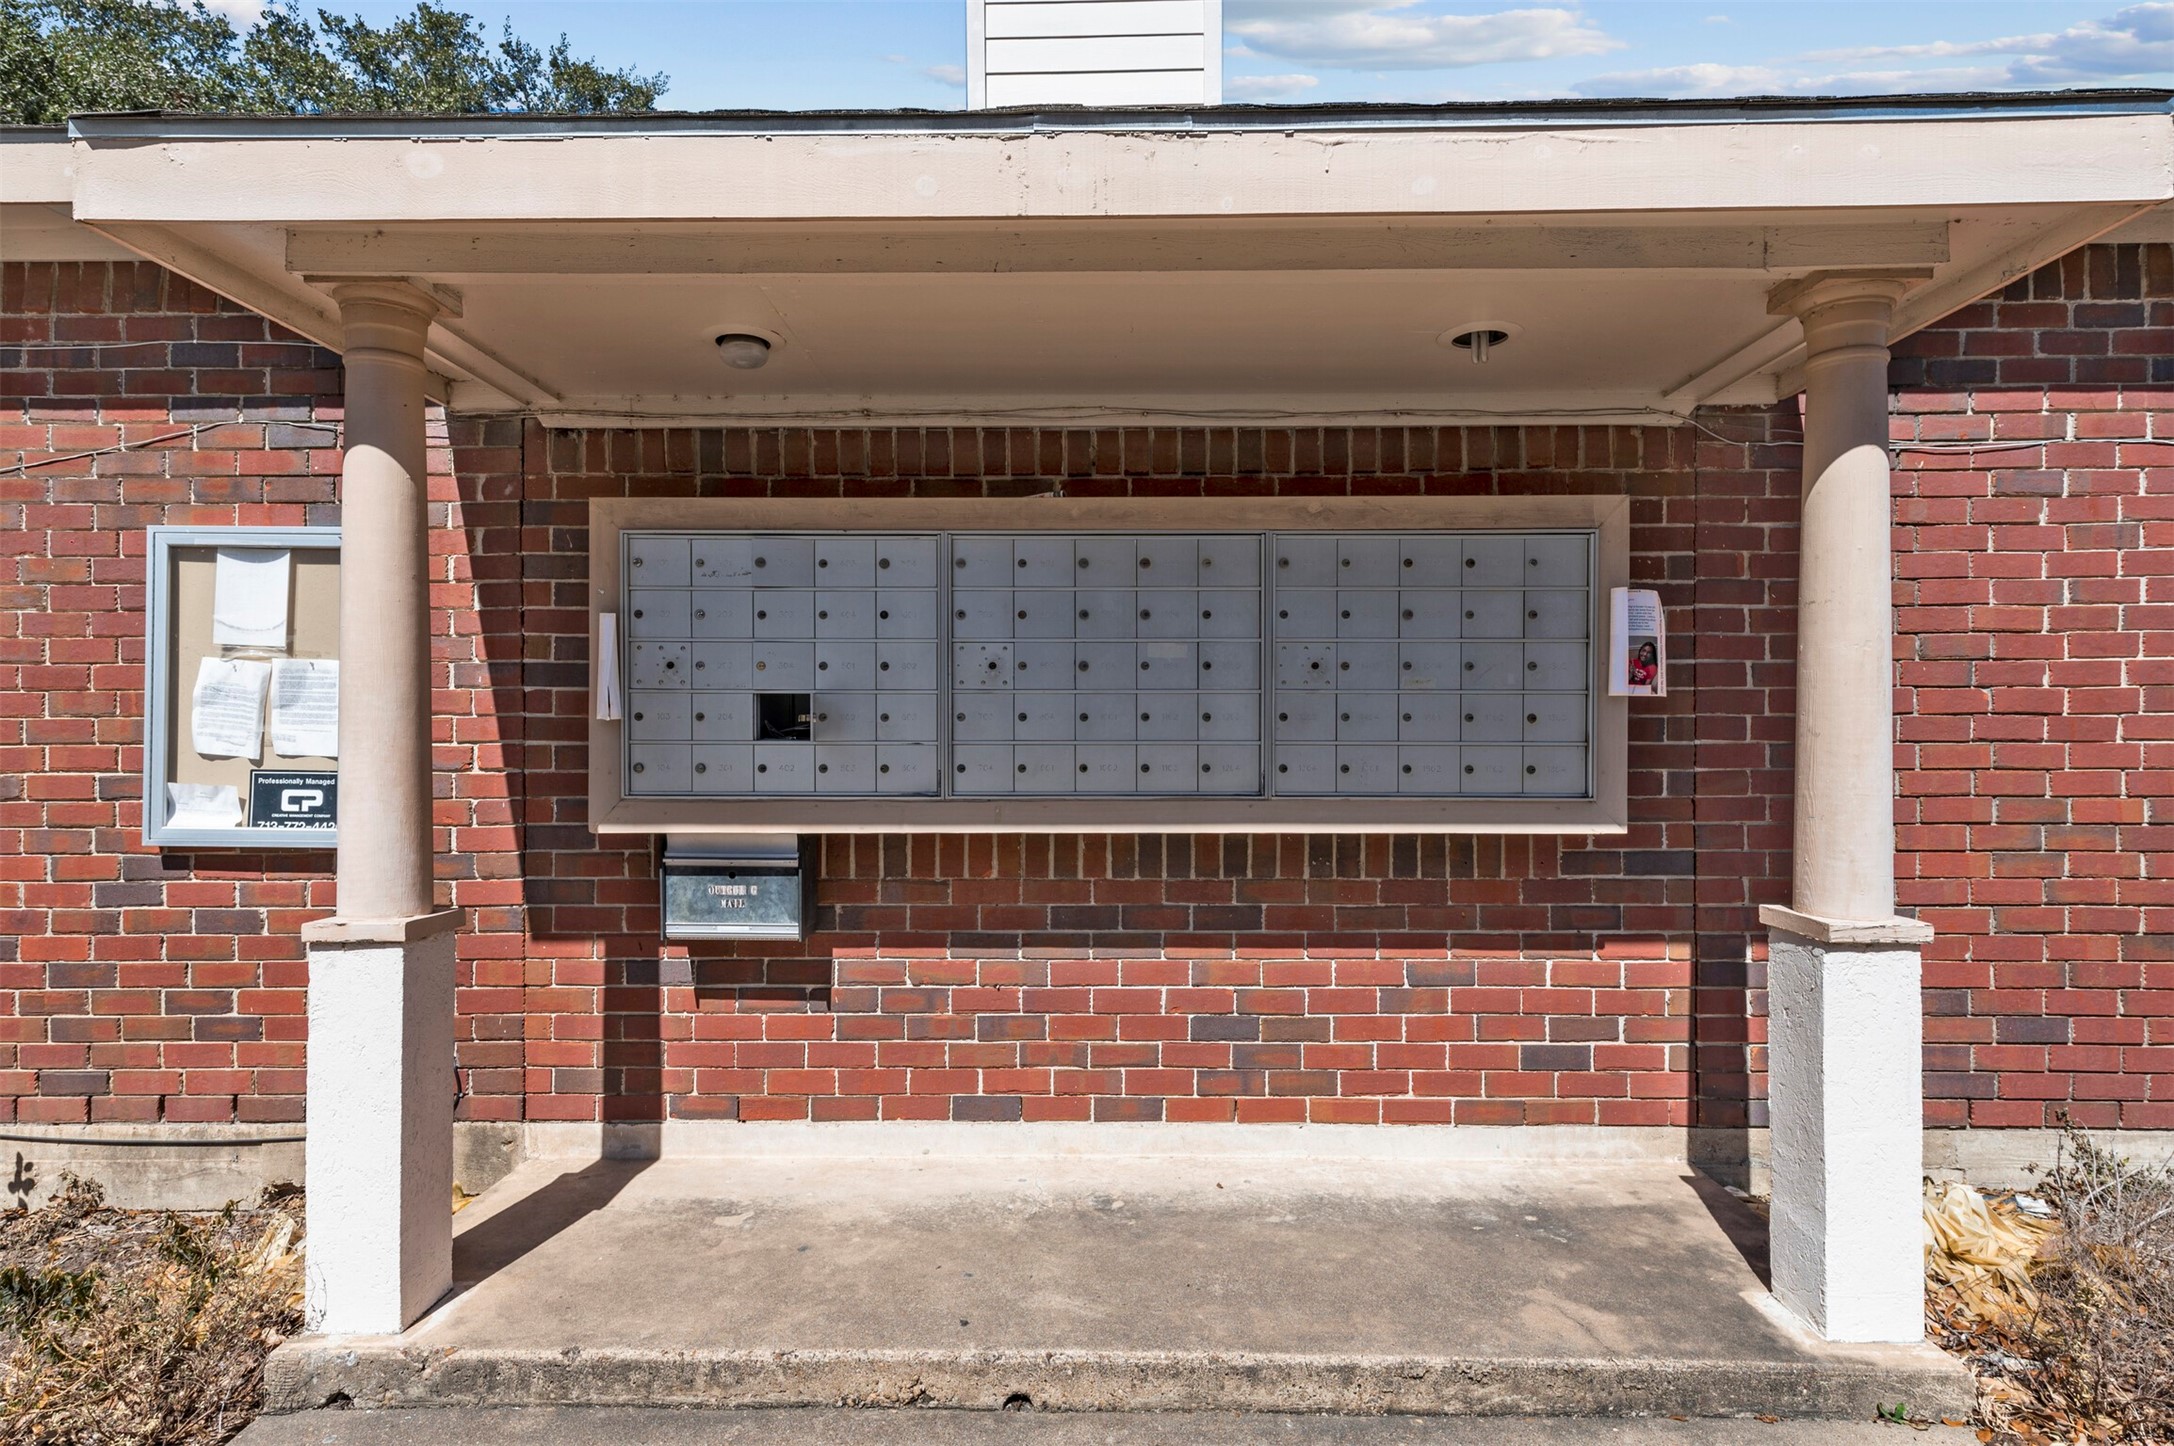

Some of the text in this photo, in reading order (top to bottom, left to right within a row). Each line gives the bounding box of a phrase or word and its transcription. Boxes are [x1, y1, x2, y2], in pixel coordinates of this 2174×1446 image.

[258, 777, 335, 786] Professionally Managed
[281, 789, 323, 812] CP
[257, 821, 337, 829] 713-772-442
[721, 899, 745, 908] MAIL
